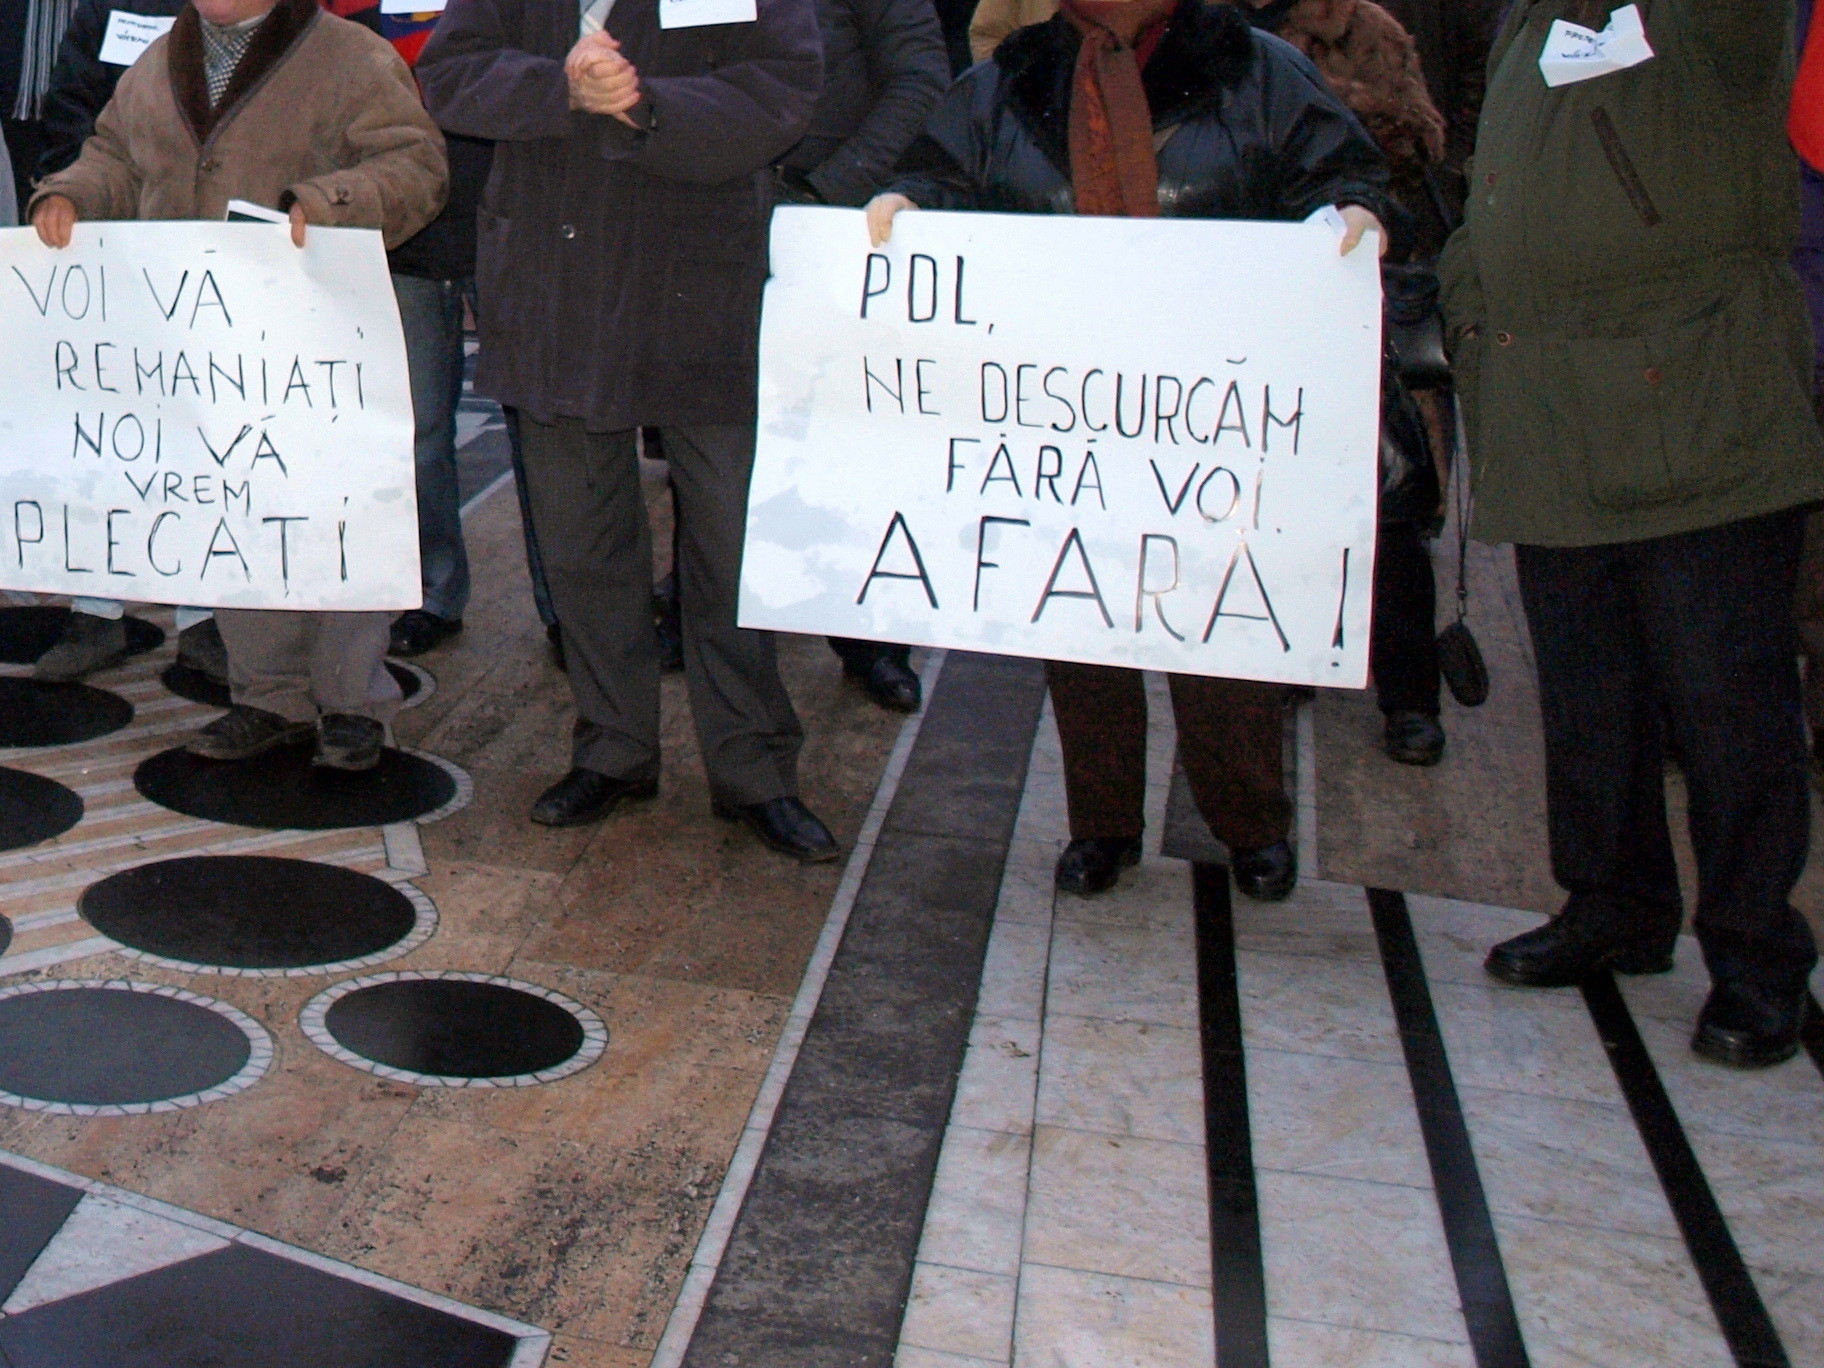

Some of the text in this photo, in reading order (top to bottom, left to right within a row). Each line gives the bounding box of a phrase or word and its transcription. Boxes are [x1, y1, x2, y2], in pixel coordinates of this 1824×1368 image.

[12, 238, 233, 330] VOI VĂ
[859, 252, 995, 335] PDL,
[73, 404, 163, 464] NOI
[864, 356, 1304, 455] NE DESCURCĂM
[124, 471, 252, 516] VREM
[946, 433, 1107, 510] FĂRĂ
